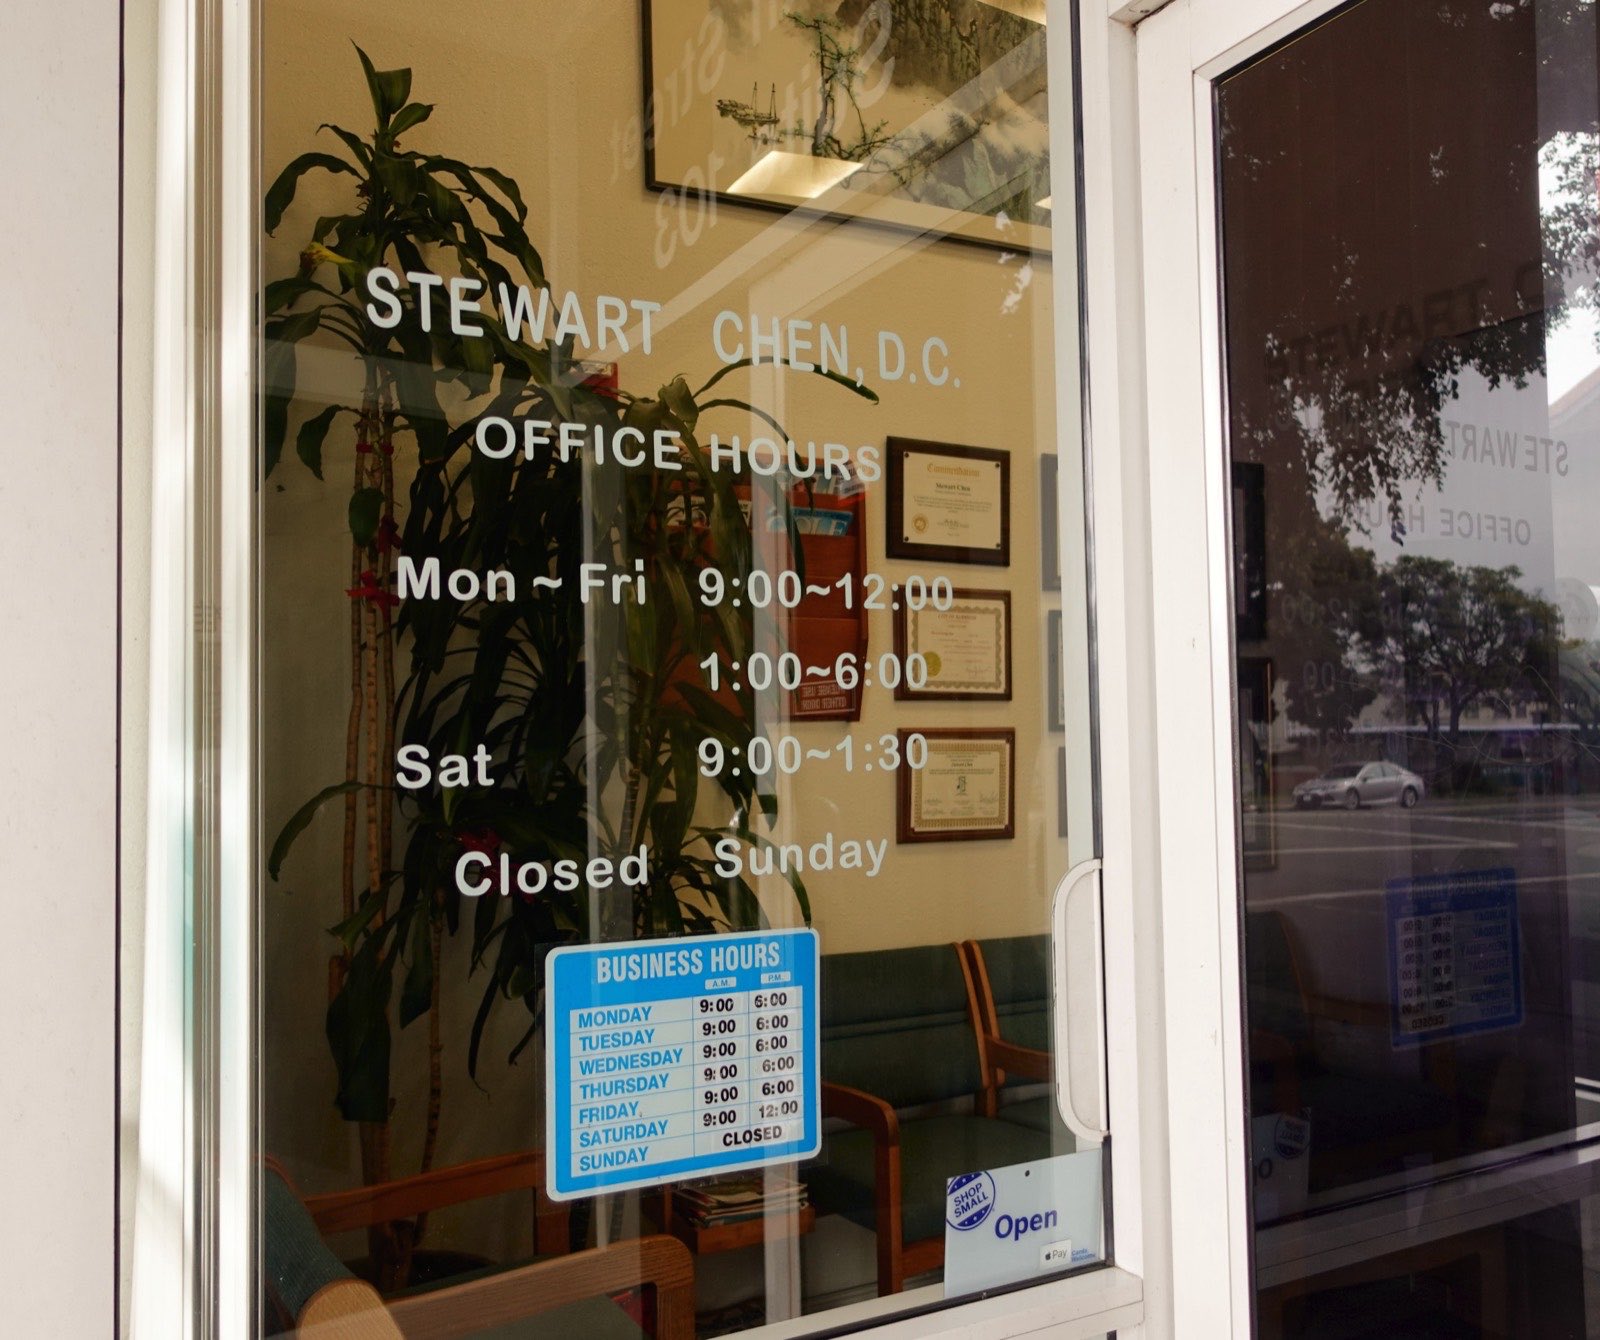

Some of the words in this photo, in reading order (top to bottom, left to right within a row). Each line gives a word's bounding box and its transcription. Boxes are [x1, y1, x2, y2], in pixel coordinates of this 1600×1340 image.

[366, 265, 662, 356] STEWART
[476, 415, 682, 471] OFFICE
[710, 433, 882, 483] HOURS
[396, 556, 517, 602] Mon
[579, 558, 648, 605] Fri
[698, 567, 954, 612] 9:00~12:00
[699, 652, 929, 693] 1:00~6:00
[395, 743, 495, 791] Sat
[697, 733, 929, 777] 9:00~1:30
[455, 844, 649, 898] Closed
[714, 833, 889, 881] Sunday
[596, 948, 703, 984] BUSINESS
[710, 942, 780, 973] HOURS
[712, 978, 731, 988] A.M.
[578, 1006, 652, 1029] MONDAY
[699, 998, 734, 1014] 9:00
[754, 992, 788, 1009] 6:00
[579, 1029, 655, 1051] TUESDAY
[702, 1019, 736, 1036] 9:00
[755, 1014, 789, 1031] 6:00
[579, 1048, 683, 1076] WEDNESDAY
[703, 1042, 736, 1059] 9:00
[755, 1035, 788, 1053] 6:00
[580, 1073, 669, 1100] THURSDAY
[704, 1064, 738, 1082] 9:00
[762, 1056, 794, 1073] 6:00
[579, 1102, 639, 1124] FRIDAY
[704, 1087, 738, 1104] 9:00
[762, 1080, 794, 1097] 6:00
[579, 1120, 668, 1148] SATURDAY
[703, 1110, 737, 1127] 9:00
[759, 1100, 798, 1119] 12:00
[579, 1147, 649, 1172] SUNDAY
[722, 1125, 783, 1147] CLOSED
[953, 1182, 984, 1208] SHOP
[954, 1191, 989, 1219] SMALL
[995, 1209, 1059, 1242] Open
[1052, 1248, 1067, 1260] Pay
